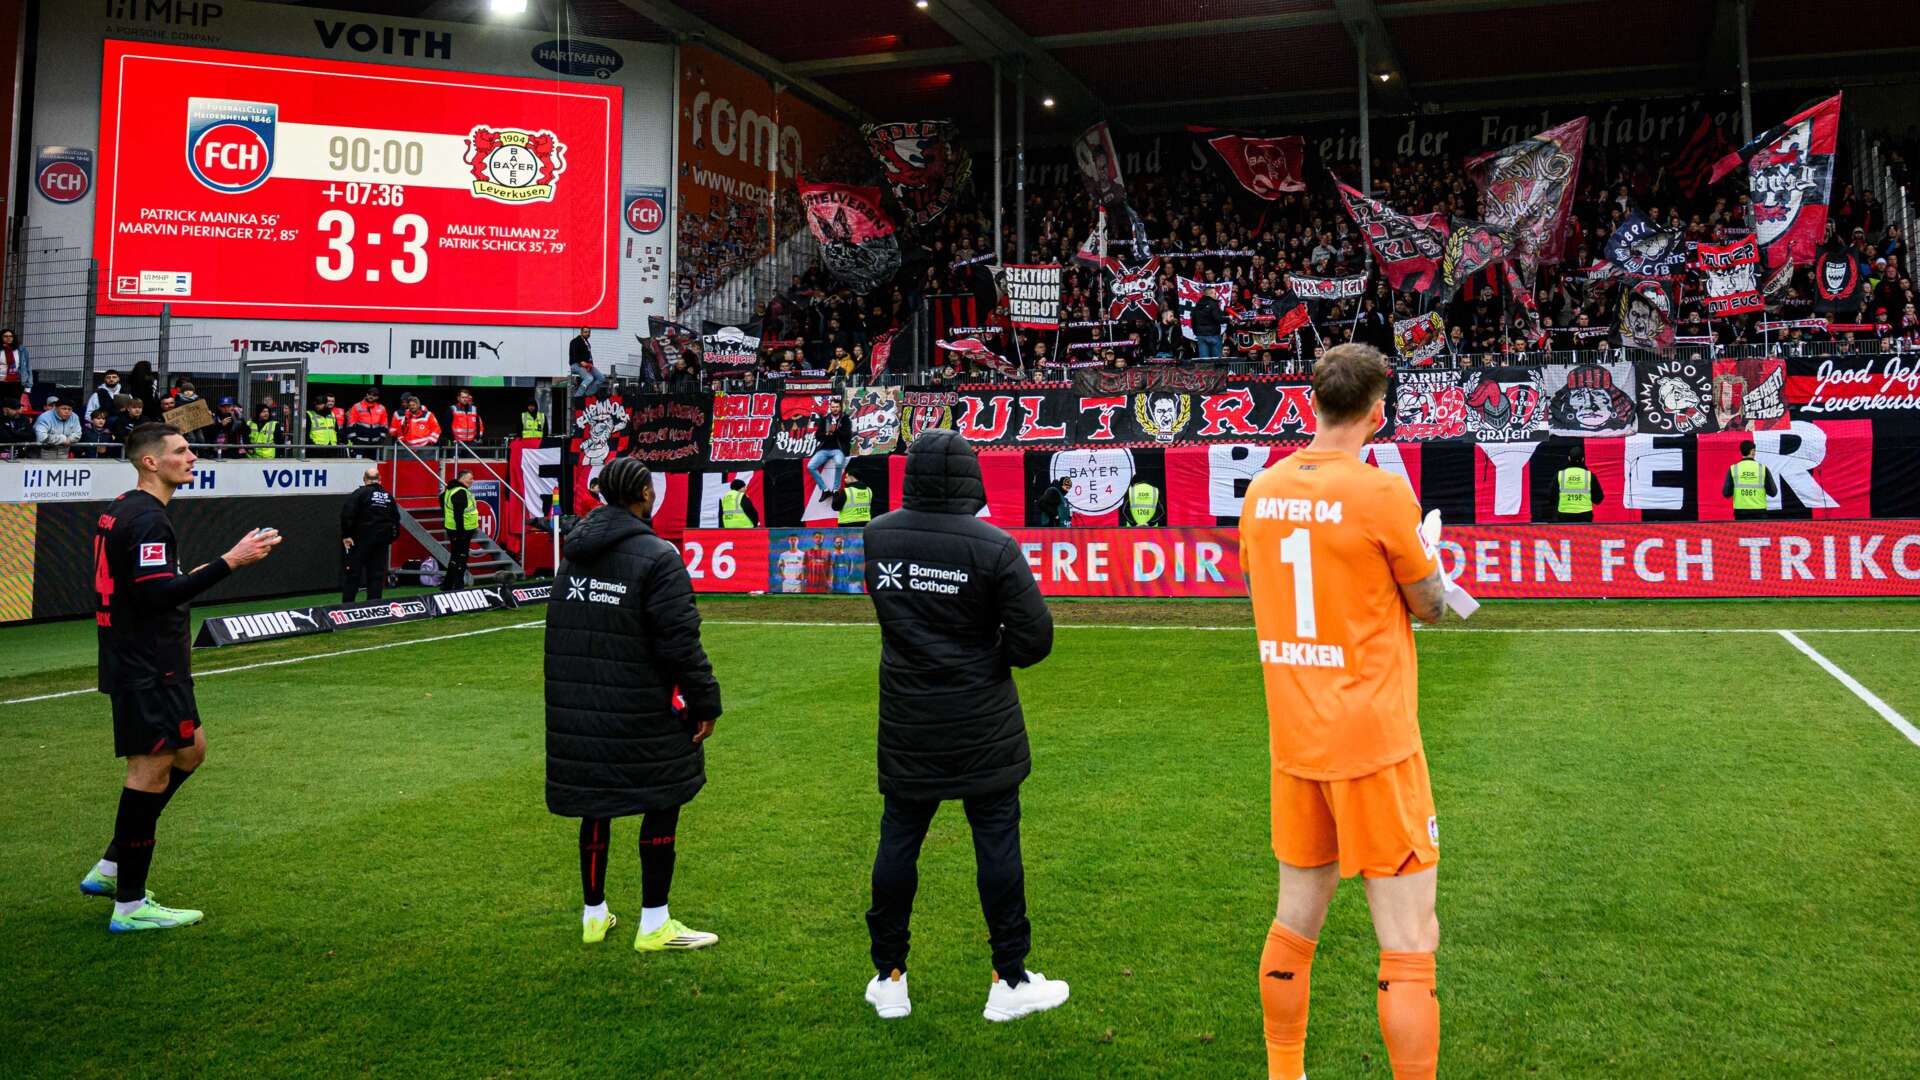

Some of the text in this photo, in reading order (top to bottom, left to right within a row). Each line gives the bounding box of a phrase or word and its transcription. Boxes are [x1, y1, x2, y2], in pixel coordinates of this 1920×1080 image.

[313, 18, 452, 60] VOITH
[539, 48, 616, 66] HARTMANN
[251, 114, 272, 124] 1846
[502, 135, 526, 145] 1904
[205, 142, 258, 171] FCH
[329, 135, 424, 176] 90:00
[493, 160, 534, 172] BAYER
[509, 147, 518, 186] BAYER
[47, 172, 82, 191] FCH
[479, 182, 546, 200] Leverkusen
[322, 182, 404, 208] +07:36
[140, 207, 281, 227] PATRICK MAINKA 56'
[632, 207, 659, 223] FCH
[118, 222, 299, 242] MARVIN PIERINGER 72', 85'
[447, 224, 560, 240] MALIK TILLMAN 22'
[439, 238, 479, 251] PATRIK
[482, 239, 527, 253] SCHICK
[549, 242, 567, 254] 79'
[1005, 267, 1061, 284] SEKTION
[1007, 282, 1060, 301] STADION
[1010, 299, 1060, 317] ERBOT
[230, 339, 370, 355] 11TEAMSPORTS
[410, 339, 477, 360] PUMA
[1398, 371, 1462, 383] FARBEN
[1743, 366, 1784, 405] FREIHEIT
[1814, 359, 1874, 396] Jood
[1640, 361, 1697, 430] COMMANDO
[1763, 390, 1780, 409] DIE
[958, 386, 1385, 442] ULTRA
[1510, 416, 1525, 424] 04
[1745, 403, 1785, 419] ULTRAS
[46, 469, 91, 487] MHP
[262, 468, 328, 488] VOITH
[1068, 465, 1120, 479] BAYER
[1255, 497, 1343, 524] BAYER 04
[684, 541, 737, 580] 26
[1133, 541, 1226, 583] DIR
[1440, 539, 1573, 583] DEIN
[1600, 537, 1715, 583] FCH
[909, 563, 969, 583] Barmenia
[589, 578, 627, 594] Barmenia
[909, 578, 960, 595] Gothaer
[1280, 528, 1316, 639] 1
[433, 590, 488, 615] PUMA
[589, 591, 620, 606] Gothaer
[329, 601, 425, 625] 11TEAMSPORTS
[222, 610, 296, 640] PUMA
[1259, 640, 1345, 668] FLEKKEN
